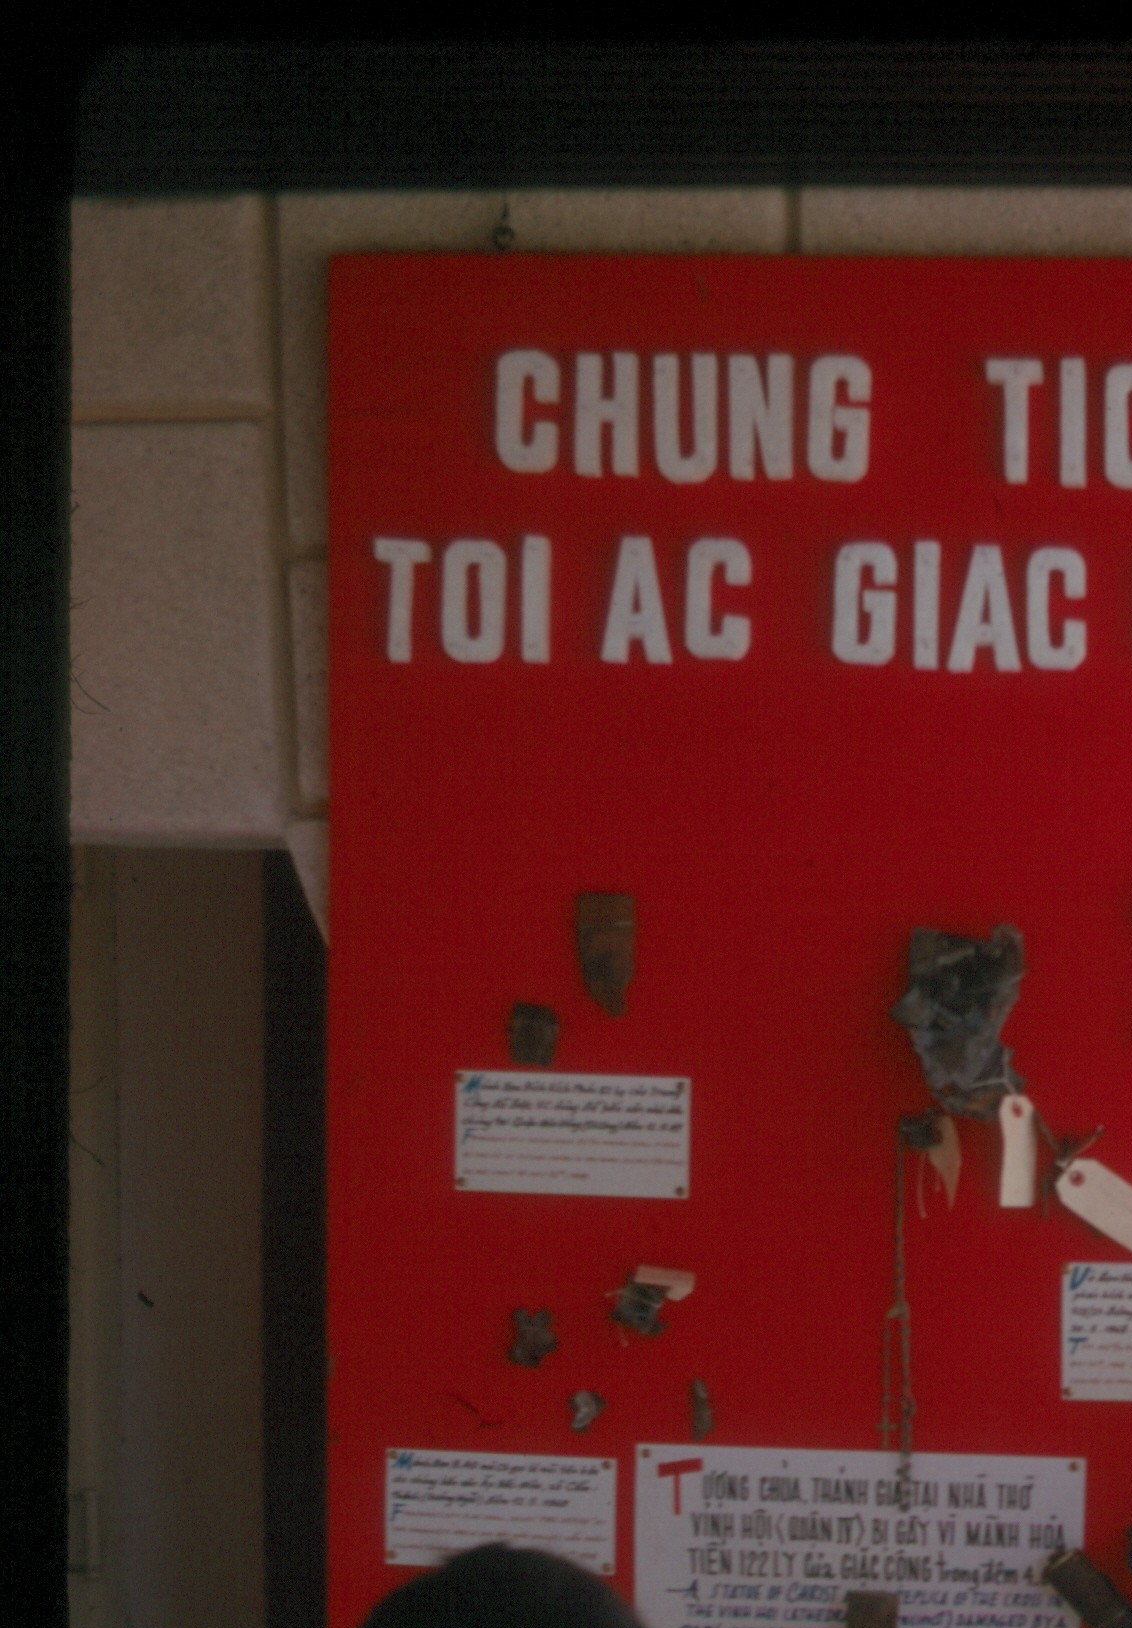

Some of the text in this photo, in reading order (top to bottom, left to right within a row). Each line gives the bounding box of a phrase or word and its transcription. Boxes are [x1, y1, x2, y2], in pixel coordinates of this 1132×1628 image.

[497, 351, 871, 482] CHUNG
[375, 536, 550, 662] TOI
[602, 537, 751, 663] AC
[832, 541, 1086, 672] GIAC
